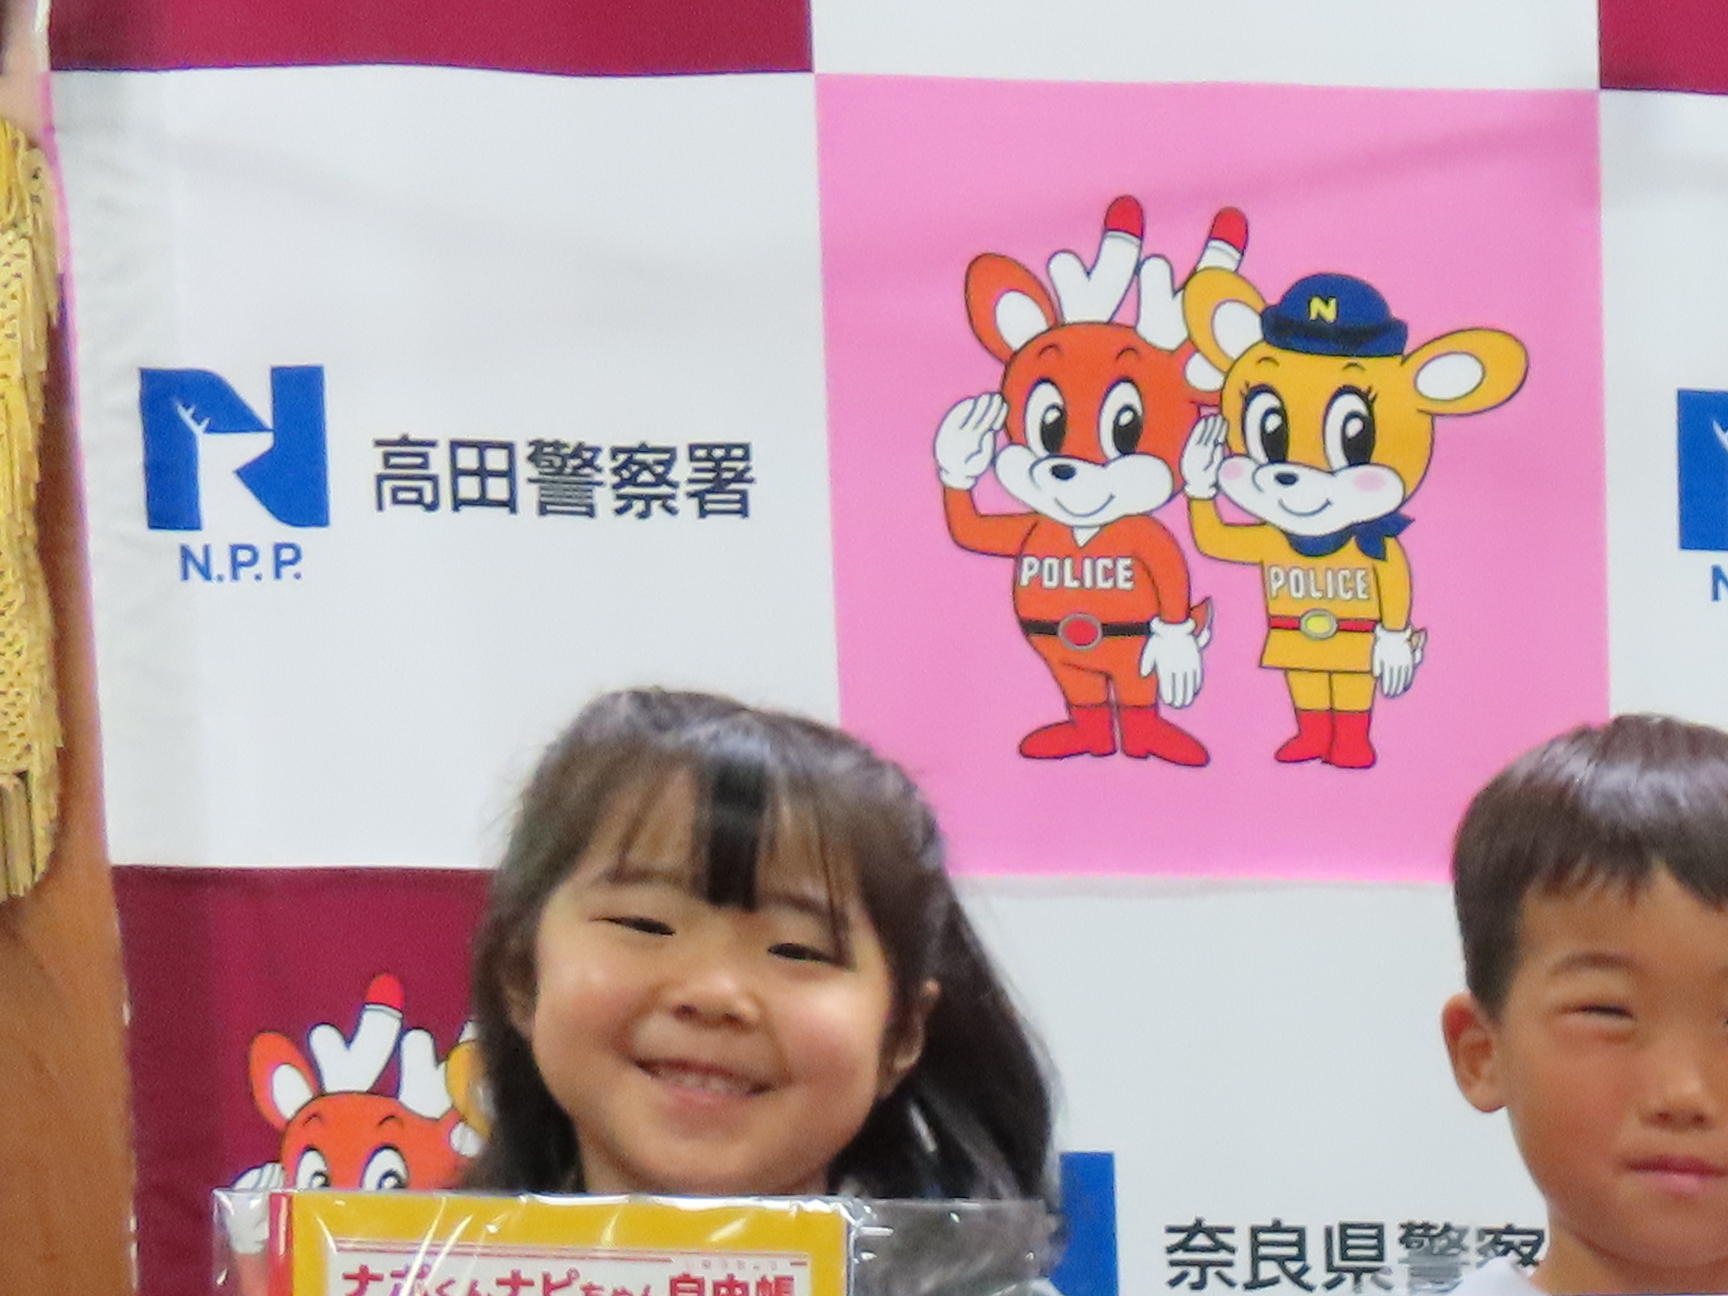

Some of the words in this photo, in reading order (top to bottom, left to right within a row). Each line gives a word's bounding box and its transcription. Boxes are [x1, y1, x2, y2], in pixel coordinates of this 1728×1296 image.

[374, 434, 755, 520] 高田警察署
[180, 542, 304, 583] N.P.P.
[1019, 555, 1136, 591] POLICE
[1268, 565, 1371, 601] POLICE
